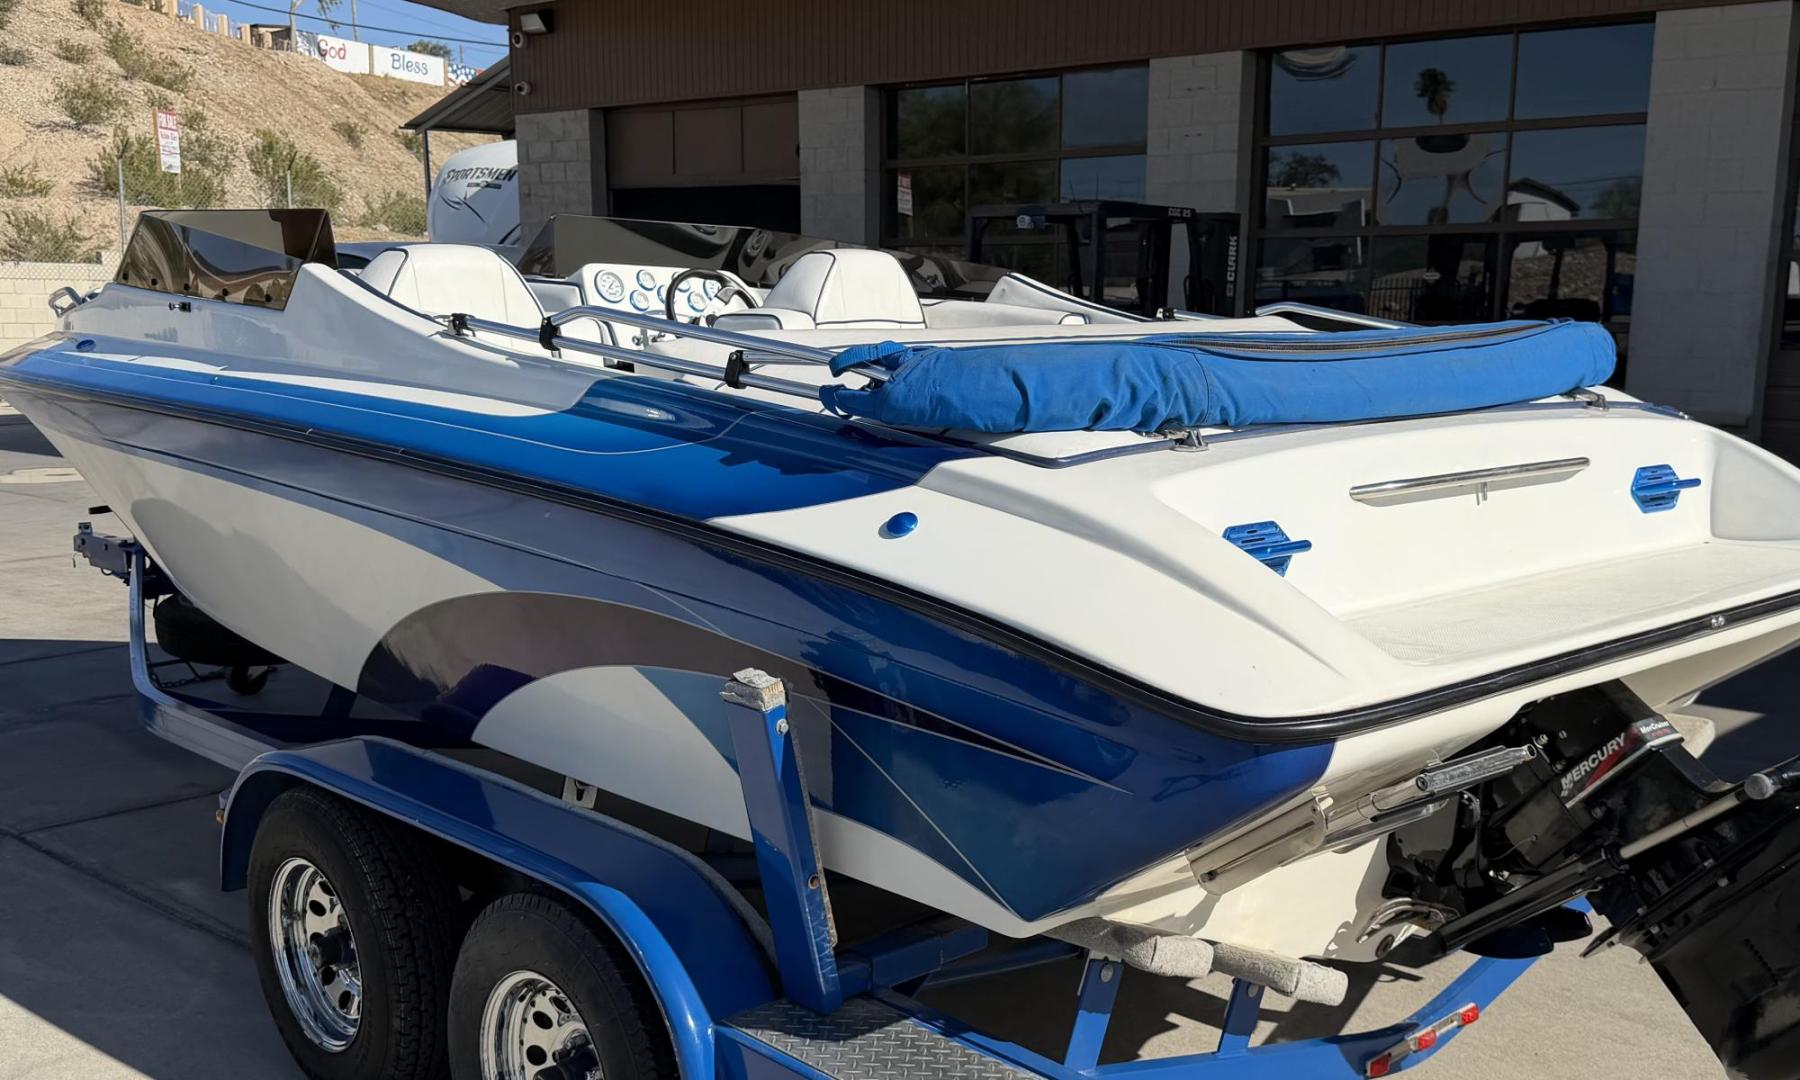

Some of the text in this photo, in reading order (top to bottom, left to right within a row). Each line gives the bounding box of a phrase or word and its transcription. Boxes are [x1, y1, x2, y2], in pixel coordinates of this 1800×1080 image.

[317, 39, 429, 76] God Bless
[447, 167, 518, 184] SPORTSMEN
[1226, 235, 1238, 281] CLARK
[1560, 732, 1626, 797] MERCURY
